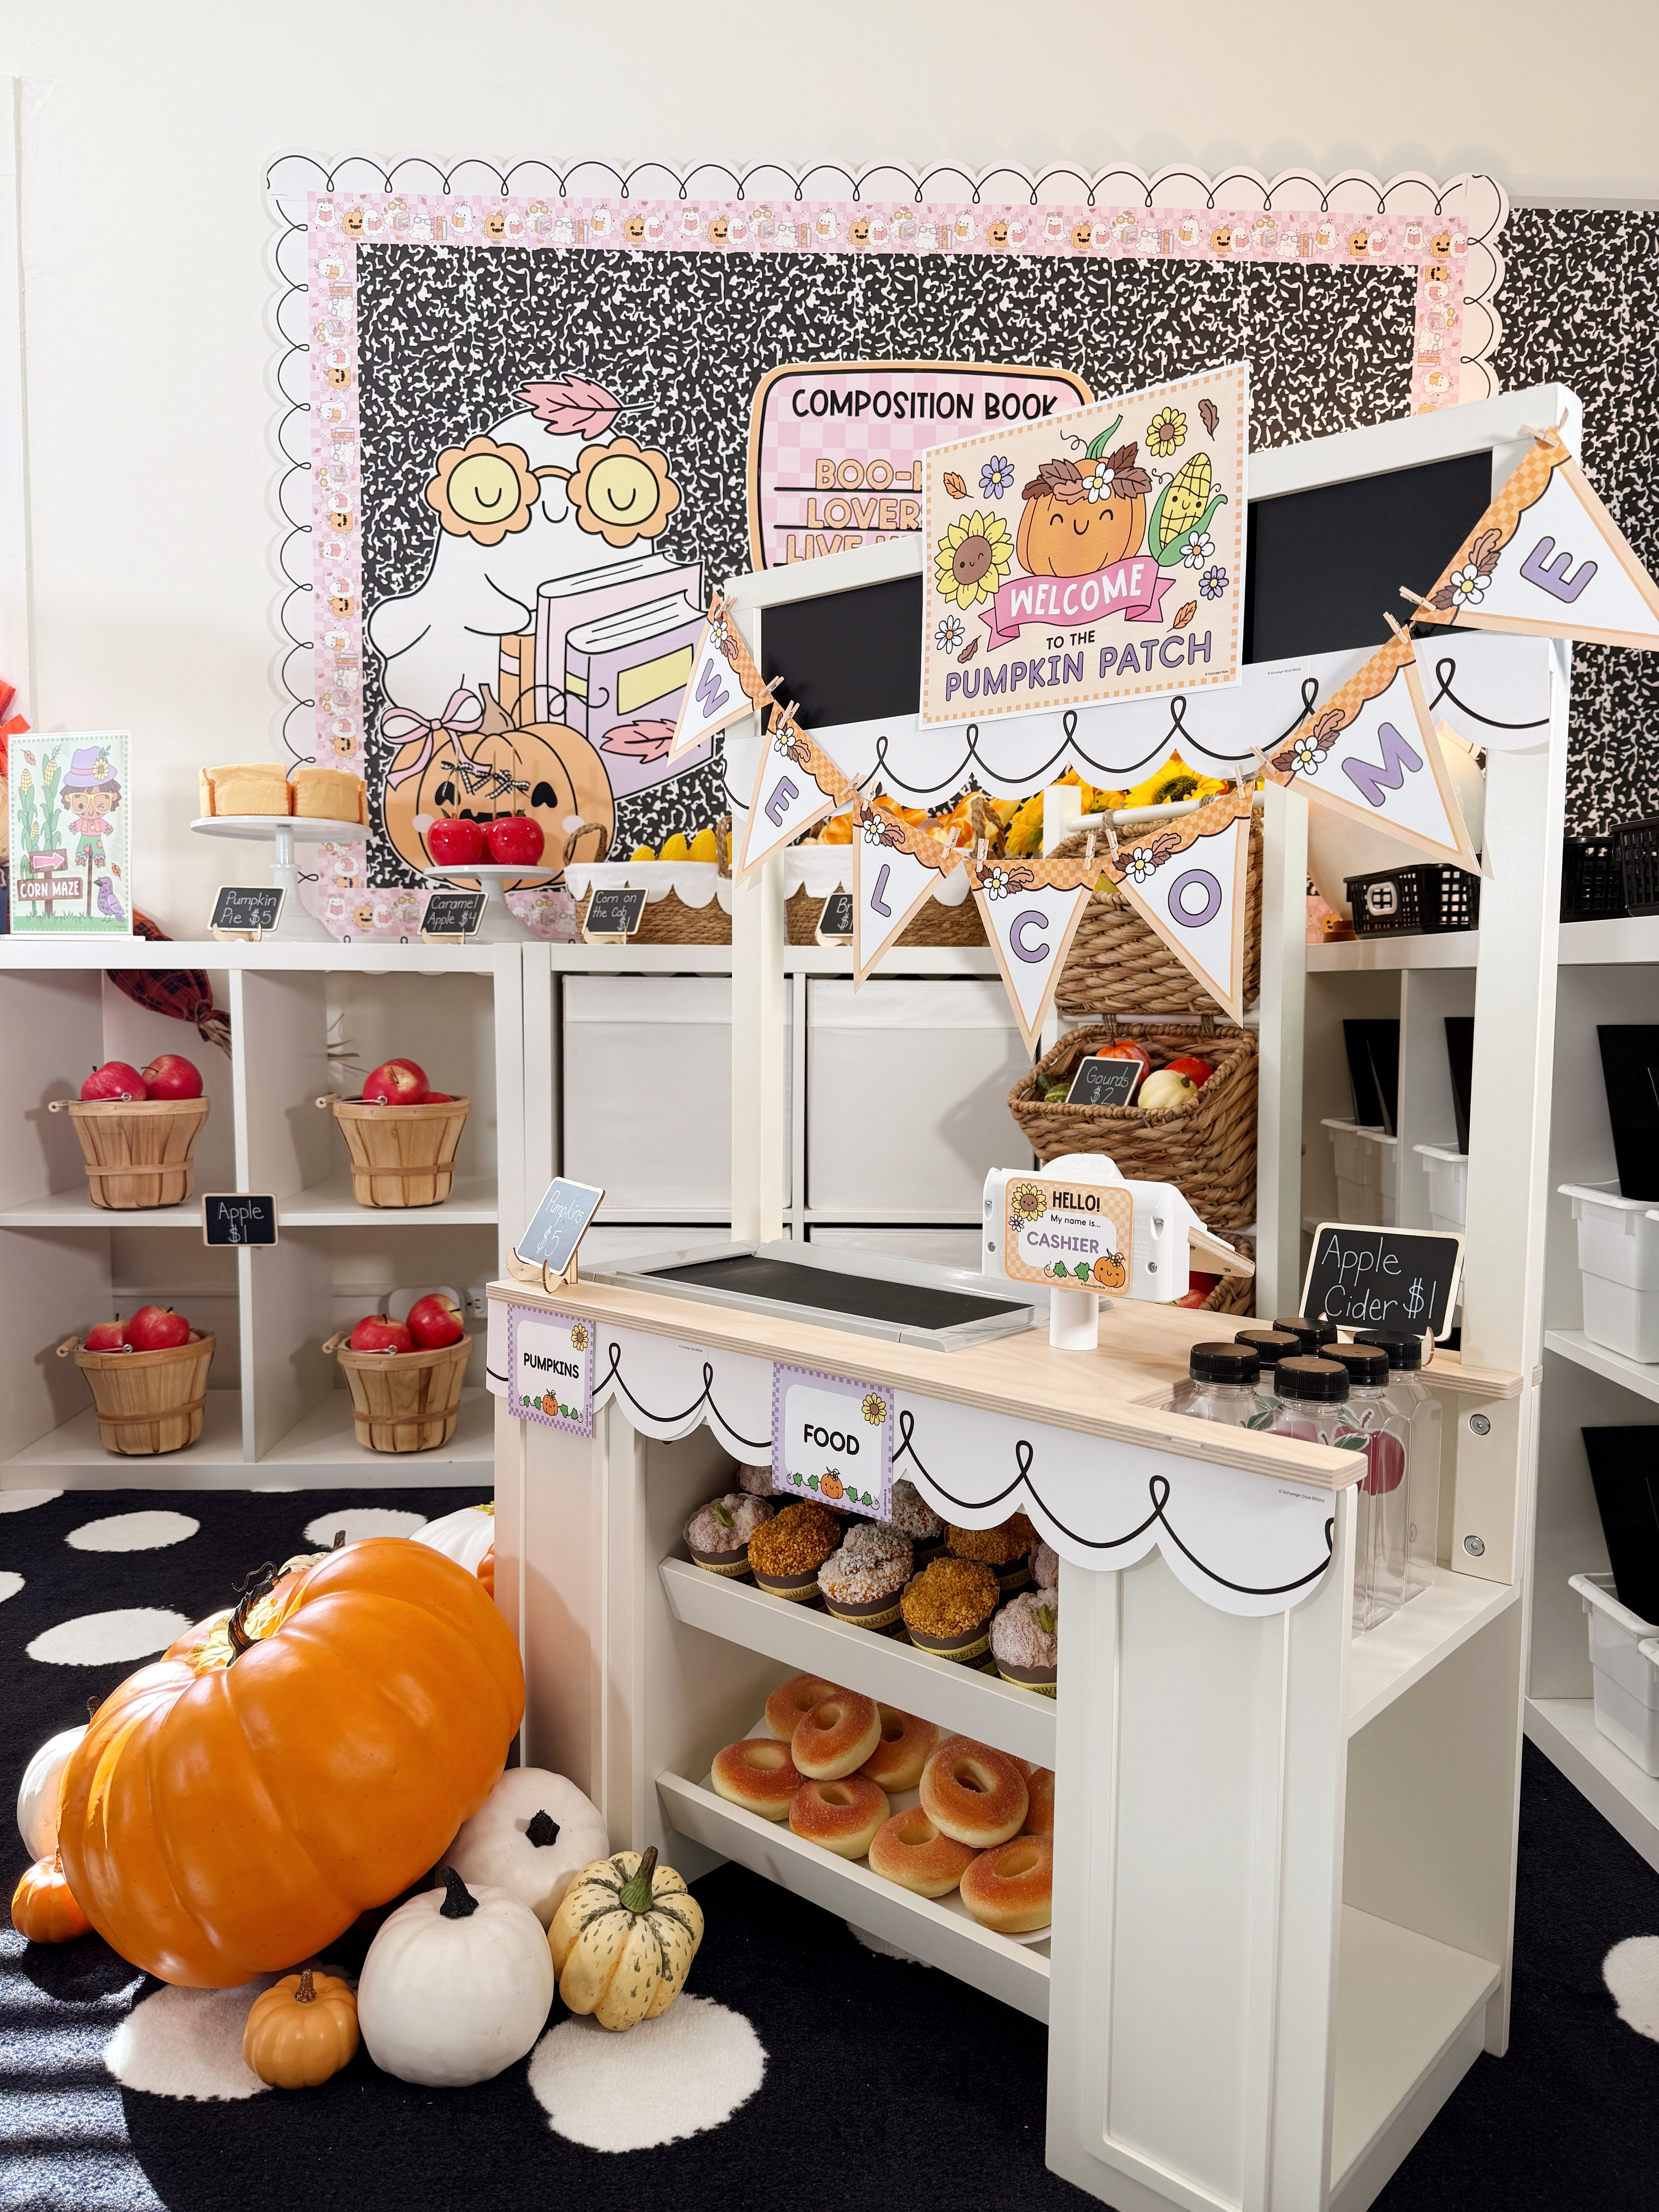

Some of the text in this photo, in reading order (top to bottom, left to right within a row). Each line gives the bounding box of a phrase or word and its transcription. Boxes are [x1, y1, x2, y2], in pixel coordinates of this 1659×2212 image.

[792, 389, 1058, 419] COMPOSITION BOOK
[1010, 563, 1145, 618] WELCOME
[1046, 630, 1096, 649] TO THE
[945, 630, 1212, 702] PUMPKIN PATCH
[20, 880, 79, 898] CORN MAZE
[596, 891, 637, 904] Corn on
[226, 891, 277, 911] Pumpkin
[430, 895, 479, 910] Caramel
[592, 905, 627, 918] the Cob
[220, 907, 271, 926] Pie $5
[427, 910, 477, 931] Apple $4
[617, 917, 630, 931] $1
[1086, 1066, 1129, 1088] Gourds
[1090, 1086, 1114, 1105] $2
[545, 1190, 584, 1227] Pumpkins
[1053, 1191, 1100, 1212] HELLO!
[218, 1199, 264, 1227] Apple
[1051, 1214, 1101, 1228] My name is...
[228, 1224, 247, 1244] $1
[536, 1225, 562, 1257] $5
[1027, 1231, 1099, 1254] CASHIER
[1321, 1235, 1402, 1286] Apple
[1325, 1277, 1436, 1321] Cider $1
[524, 1352, 579, 1379] PUMPKINS
[804, 1424, 860, 1455] FOOD
